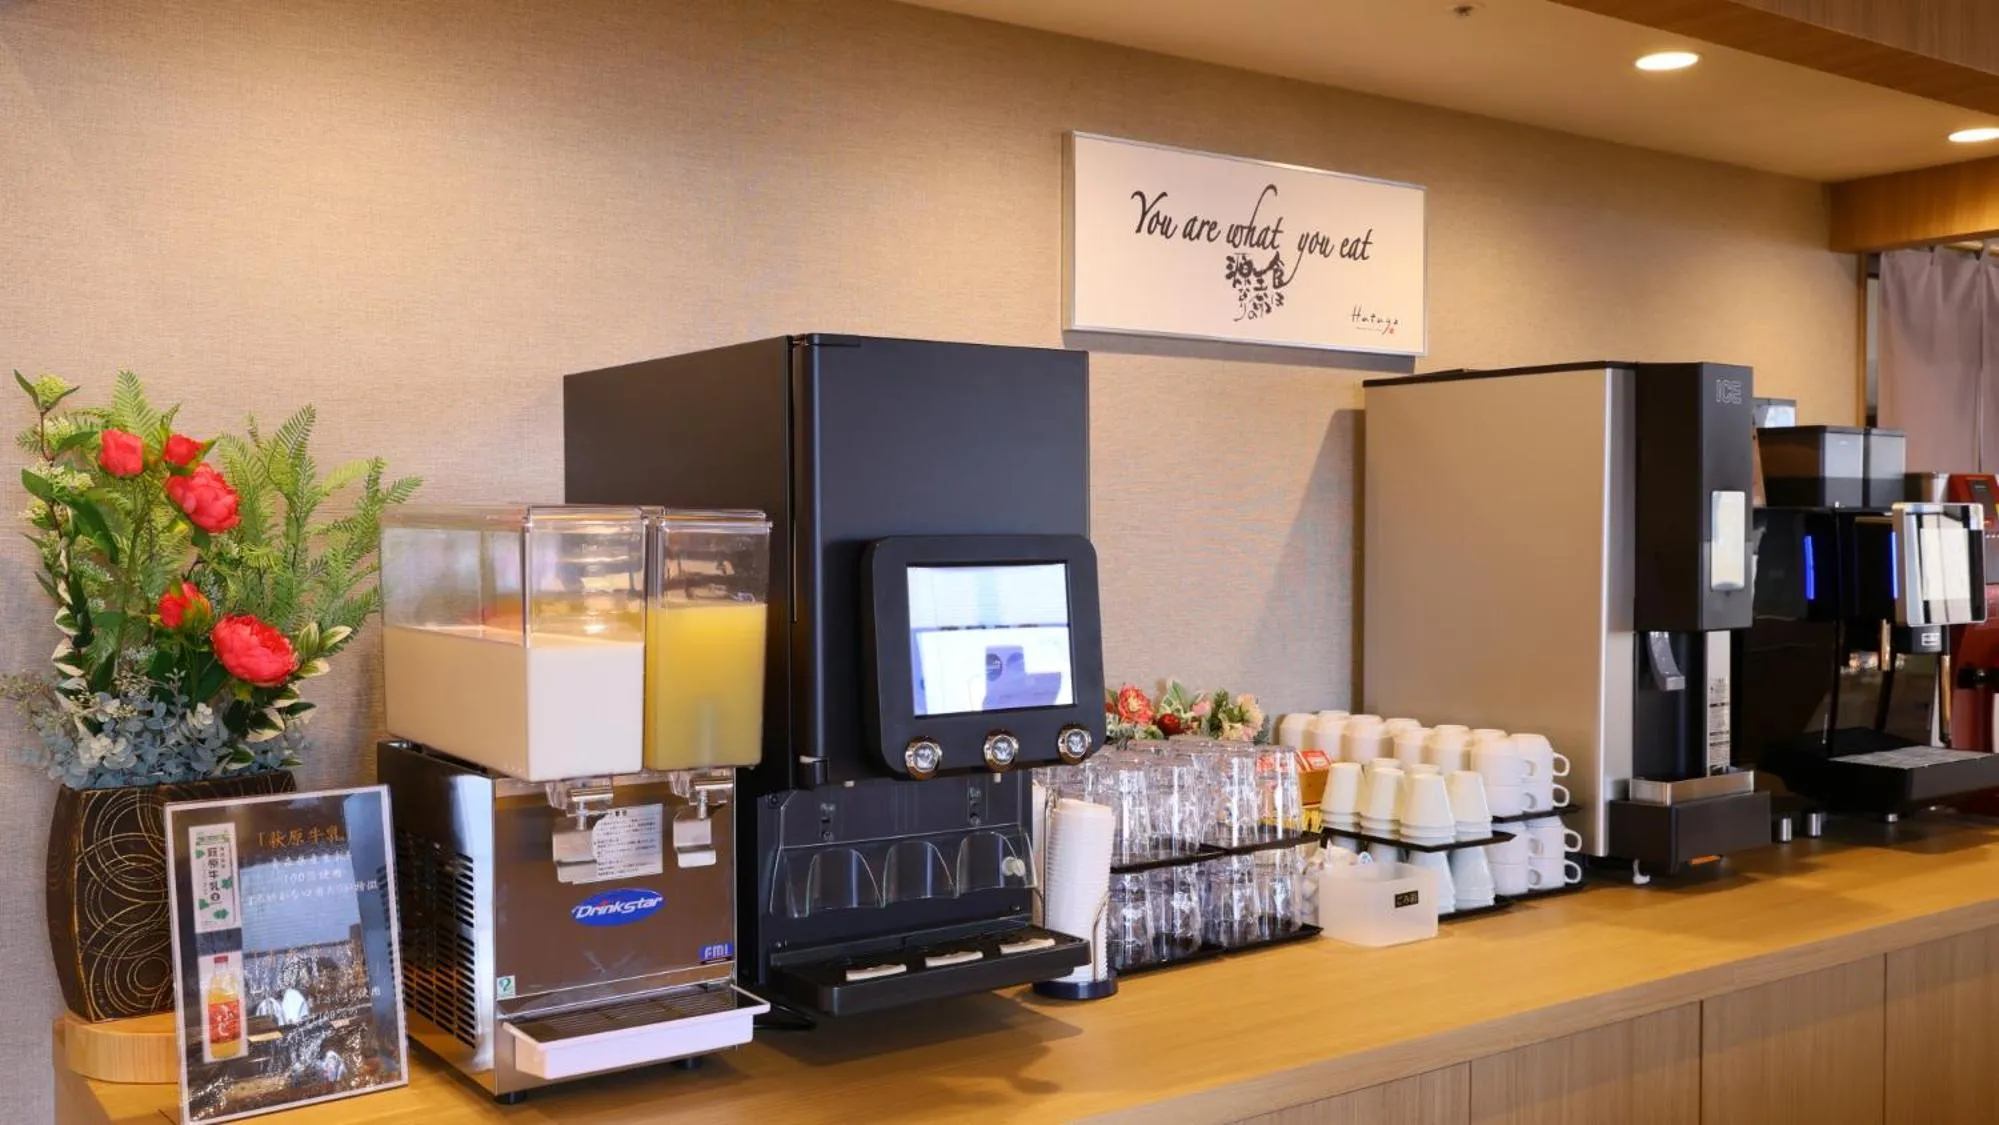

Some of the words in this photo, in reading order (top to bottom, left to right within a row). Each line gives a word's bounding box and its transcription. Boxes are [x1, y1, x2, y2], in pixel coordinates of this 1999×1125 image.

[1131, 190, 1177, 240] You
[1182, 216, 1221, 243] are
[1225, 184, 1285, 250] what
[1293, 230, 1335, 270] you
[1340, 228, 1374, 261] eat
[1715, 379, 1742, 404] ICE
[704, 943, 729, 960] FMI
